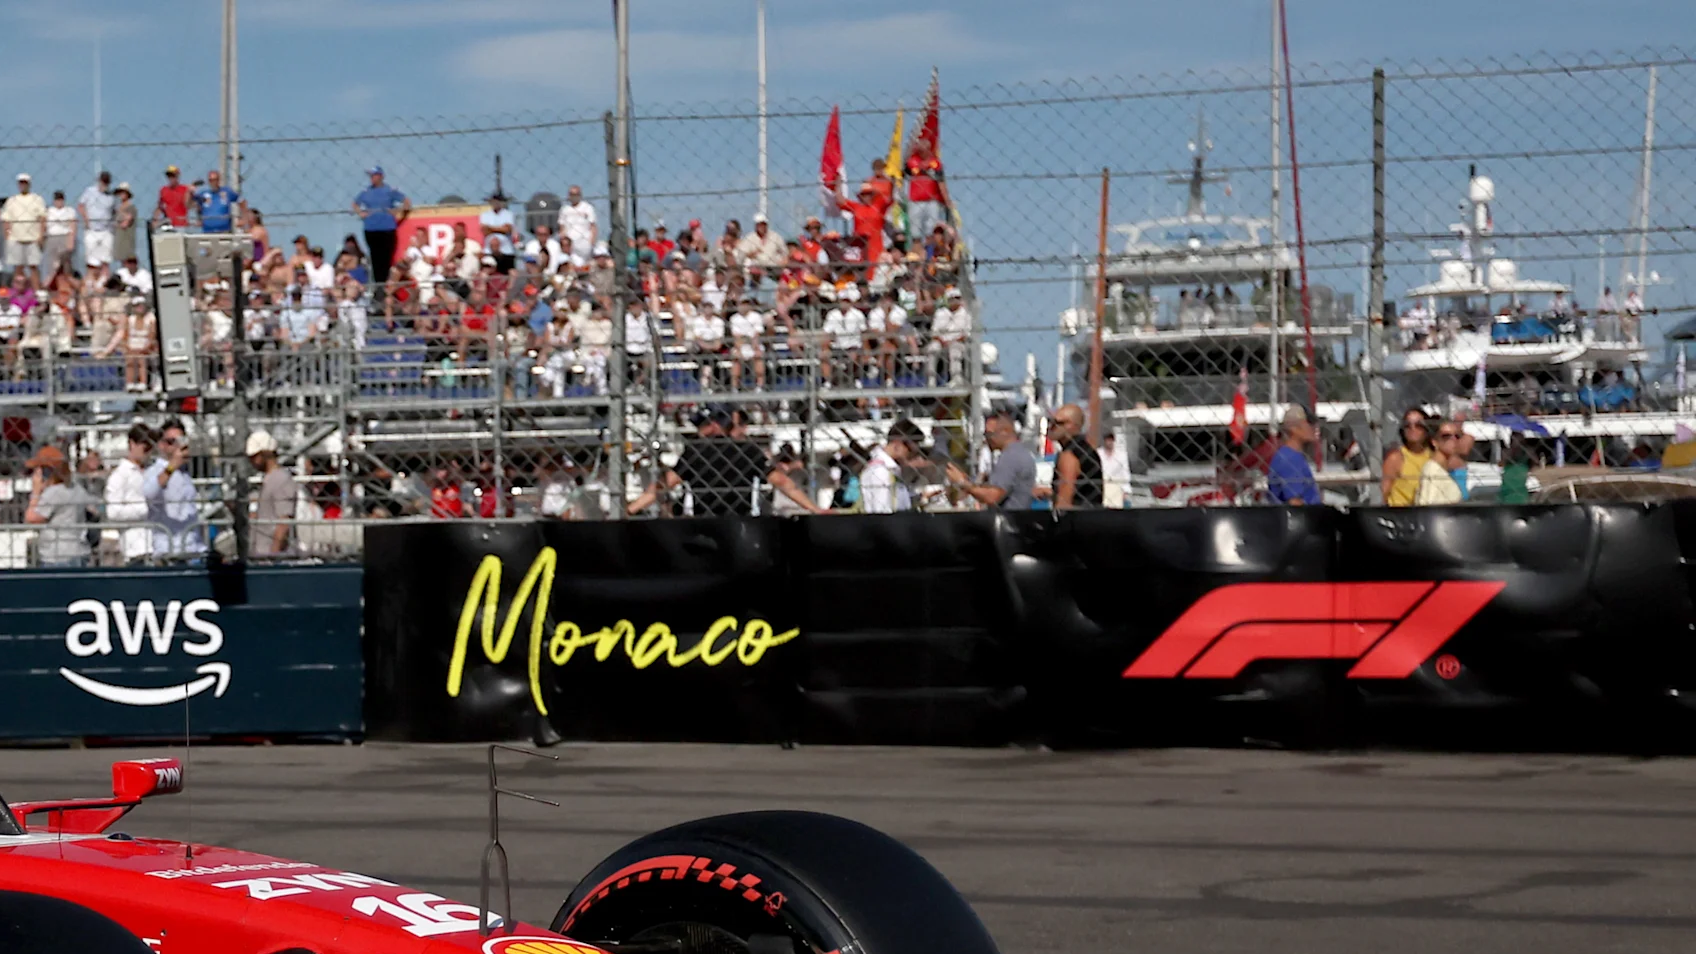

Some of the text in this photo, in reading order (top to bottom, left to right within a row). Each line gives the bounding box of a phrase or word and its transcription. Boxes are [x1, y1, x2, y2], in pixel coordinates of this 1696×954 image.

[65, 598, 224, 656] aws
[446, 546, 800, 716] Monaco
[153, 767, 181, 789] ZYN
[211, 871, 401, 900] ZYN
[351, 892, 504, 938] 16
